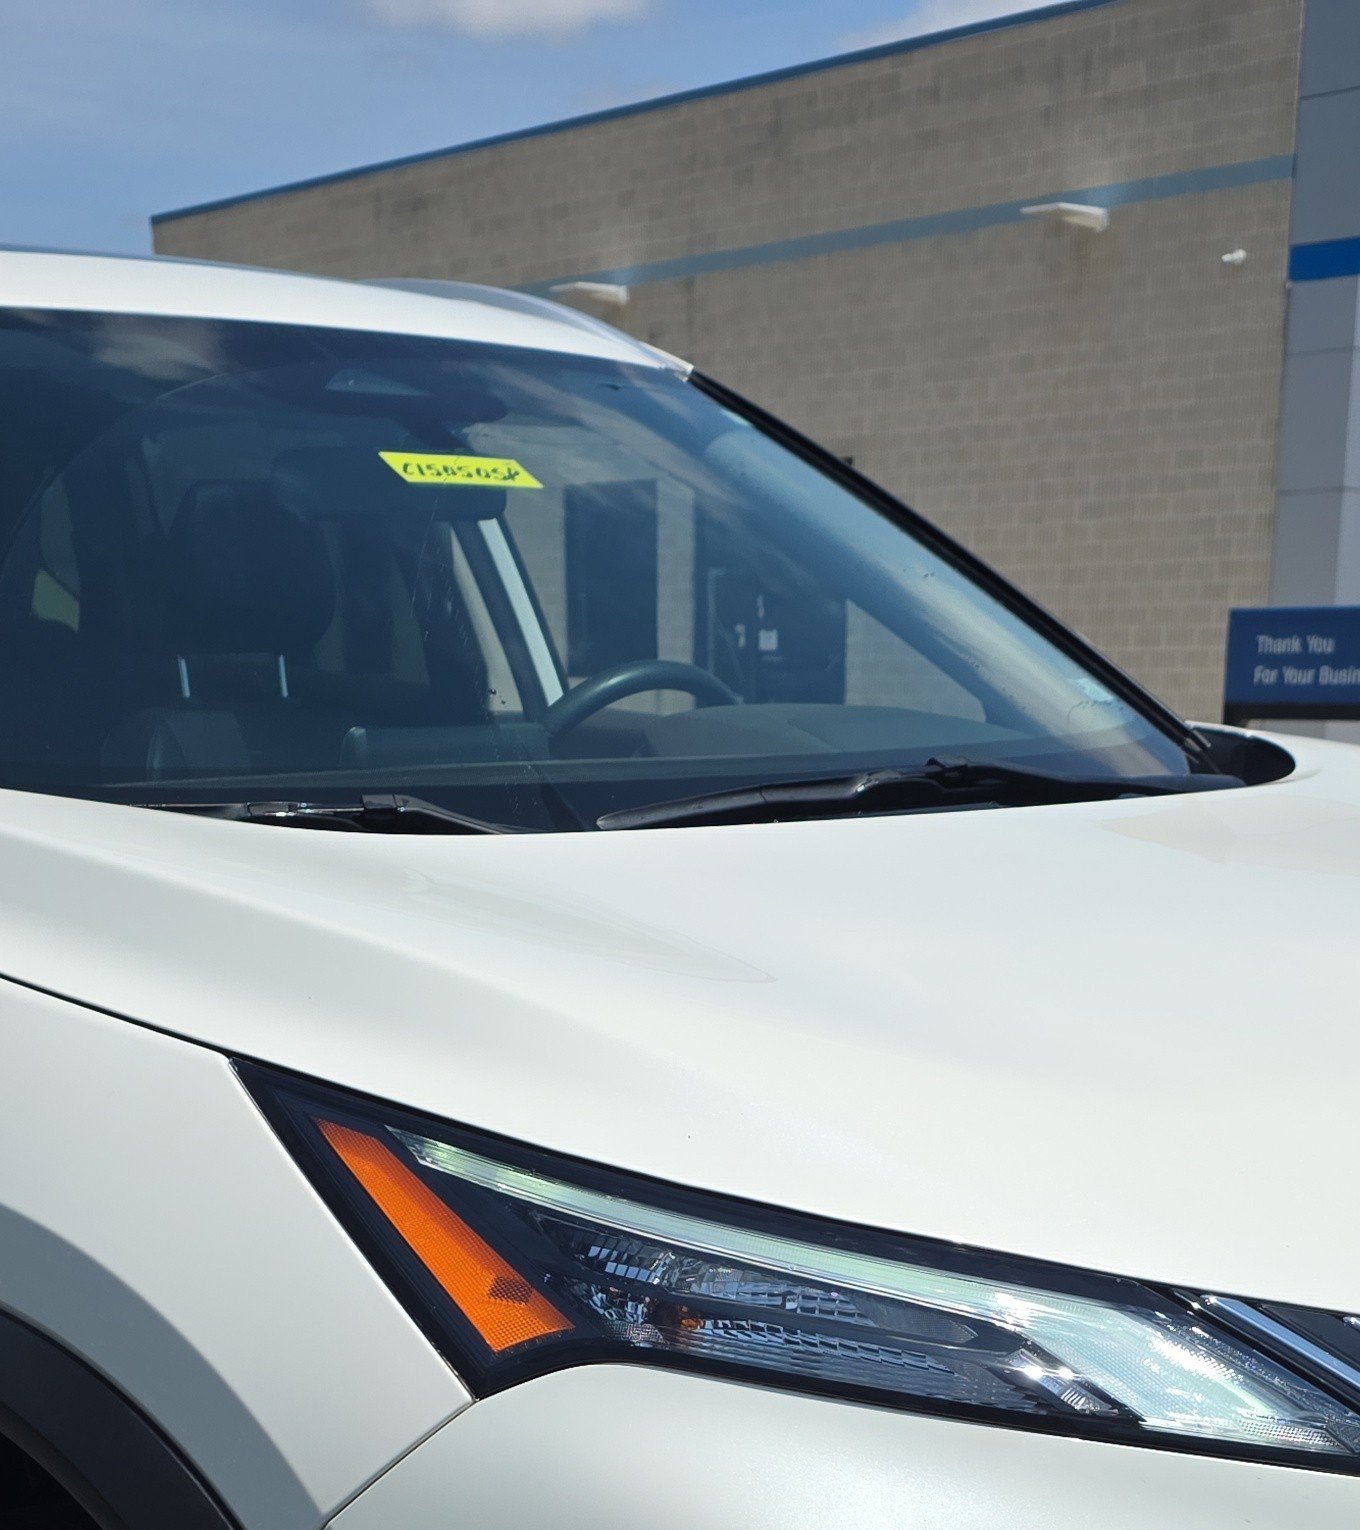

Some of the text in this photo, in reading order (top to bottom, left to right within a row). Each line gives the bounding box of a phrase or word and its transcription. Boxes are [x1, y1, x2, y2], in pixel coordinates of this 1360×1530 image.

[1257, 635, 1335, 653] Thank You
[1254, 666, 1278, 685] For
[1283, 666, 1314, 685] Your
